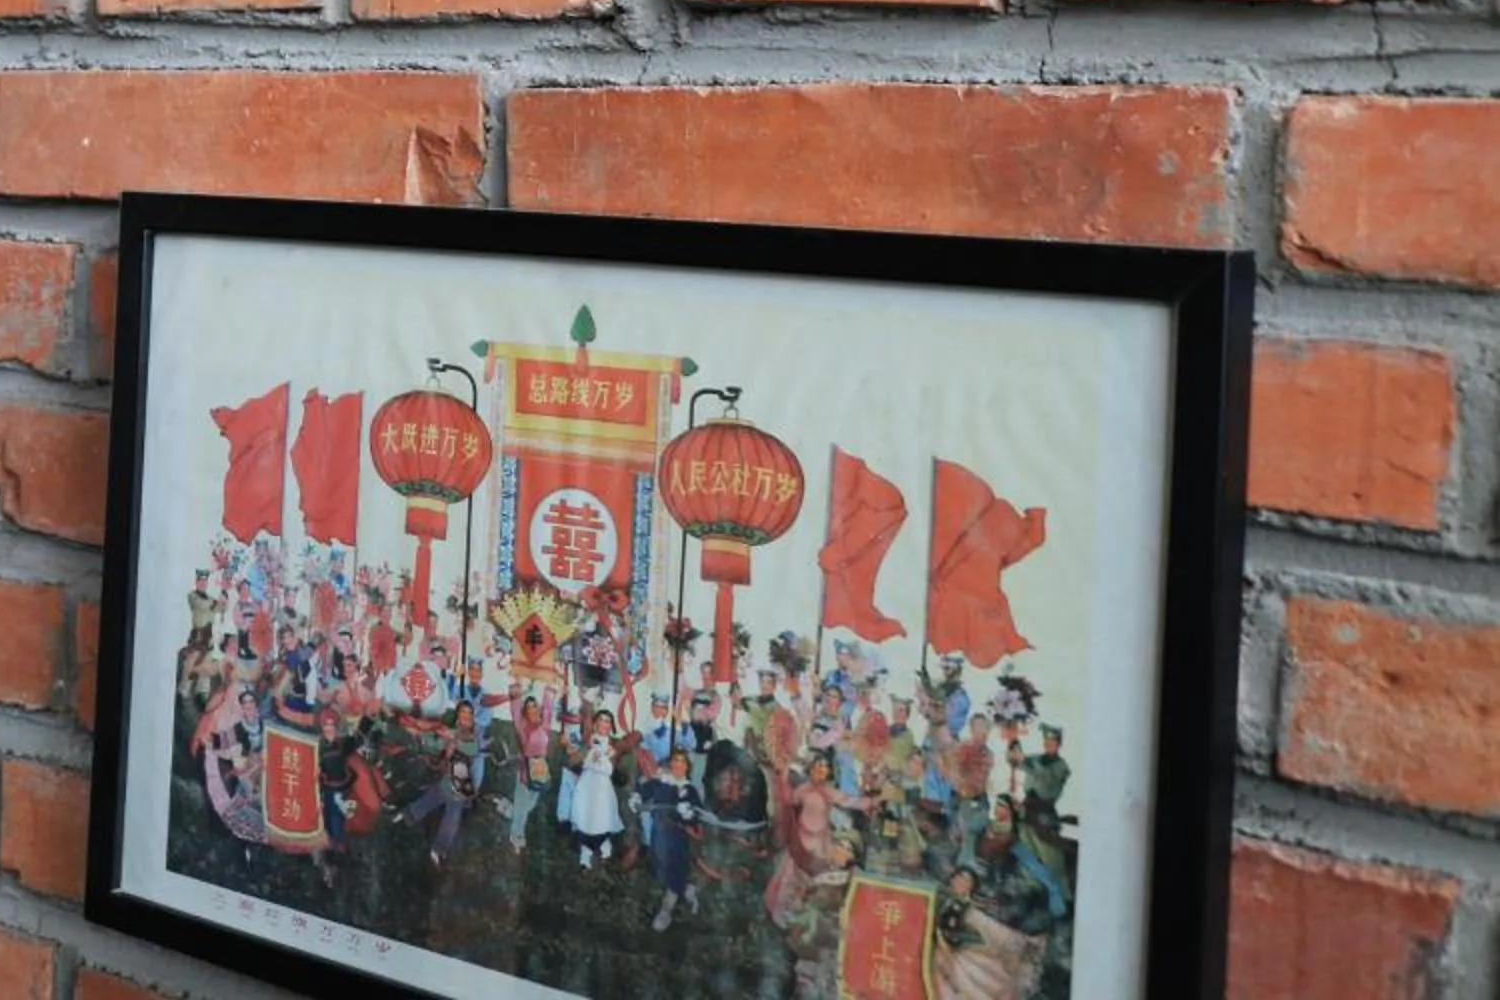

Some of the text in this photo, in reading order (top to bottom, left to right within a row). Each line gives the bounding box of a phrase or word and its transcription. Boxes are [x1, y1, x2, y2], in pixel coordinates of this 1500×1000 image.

[529, 372, 634, 411] 总路线万岁
[380, 423, 480, 461] 大跃进万岁
[670, 459, 798, 502] 人民公社万岁
